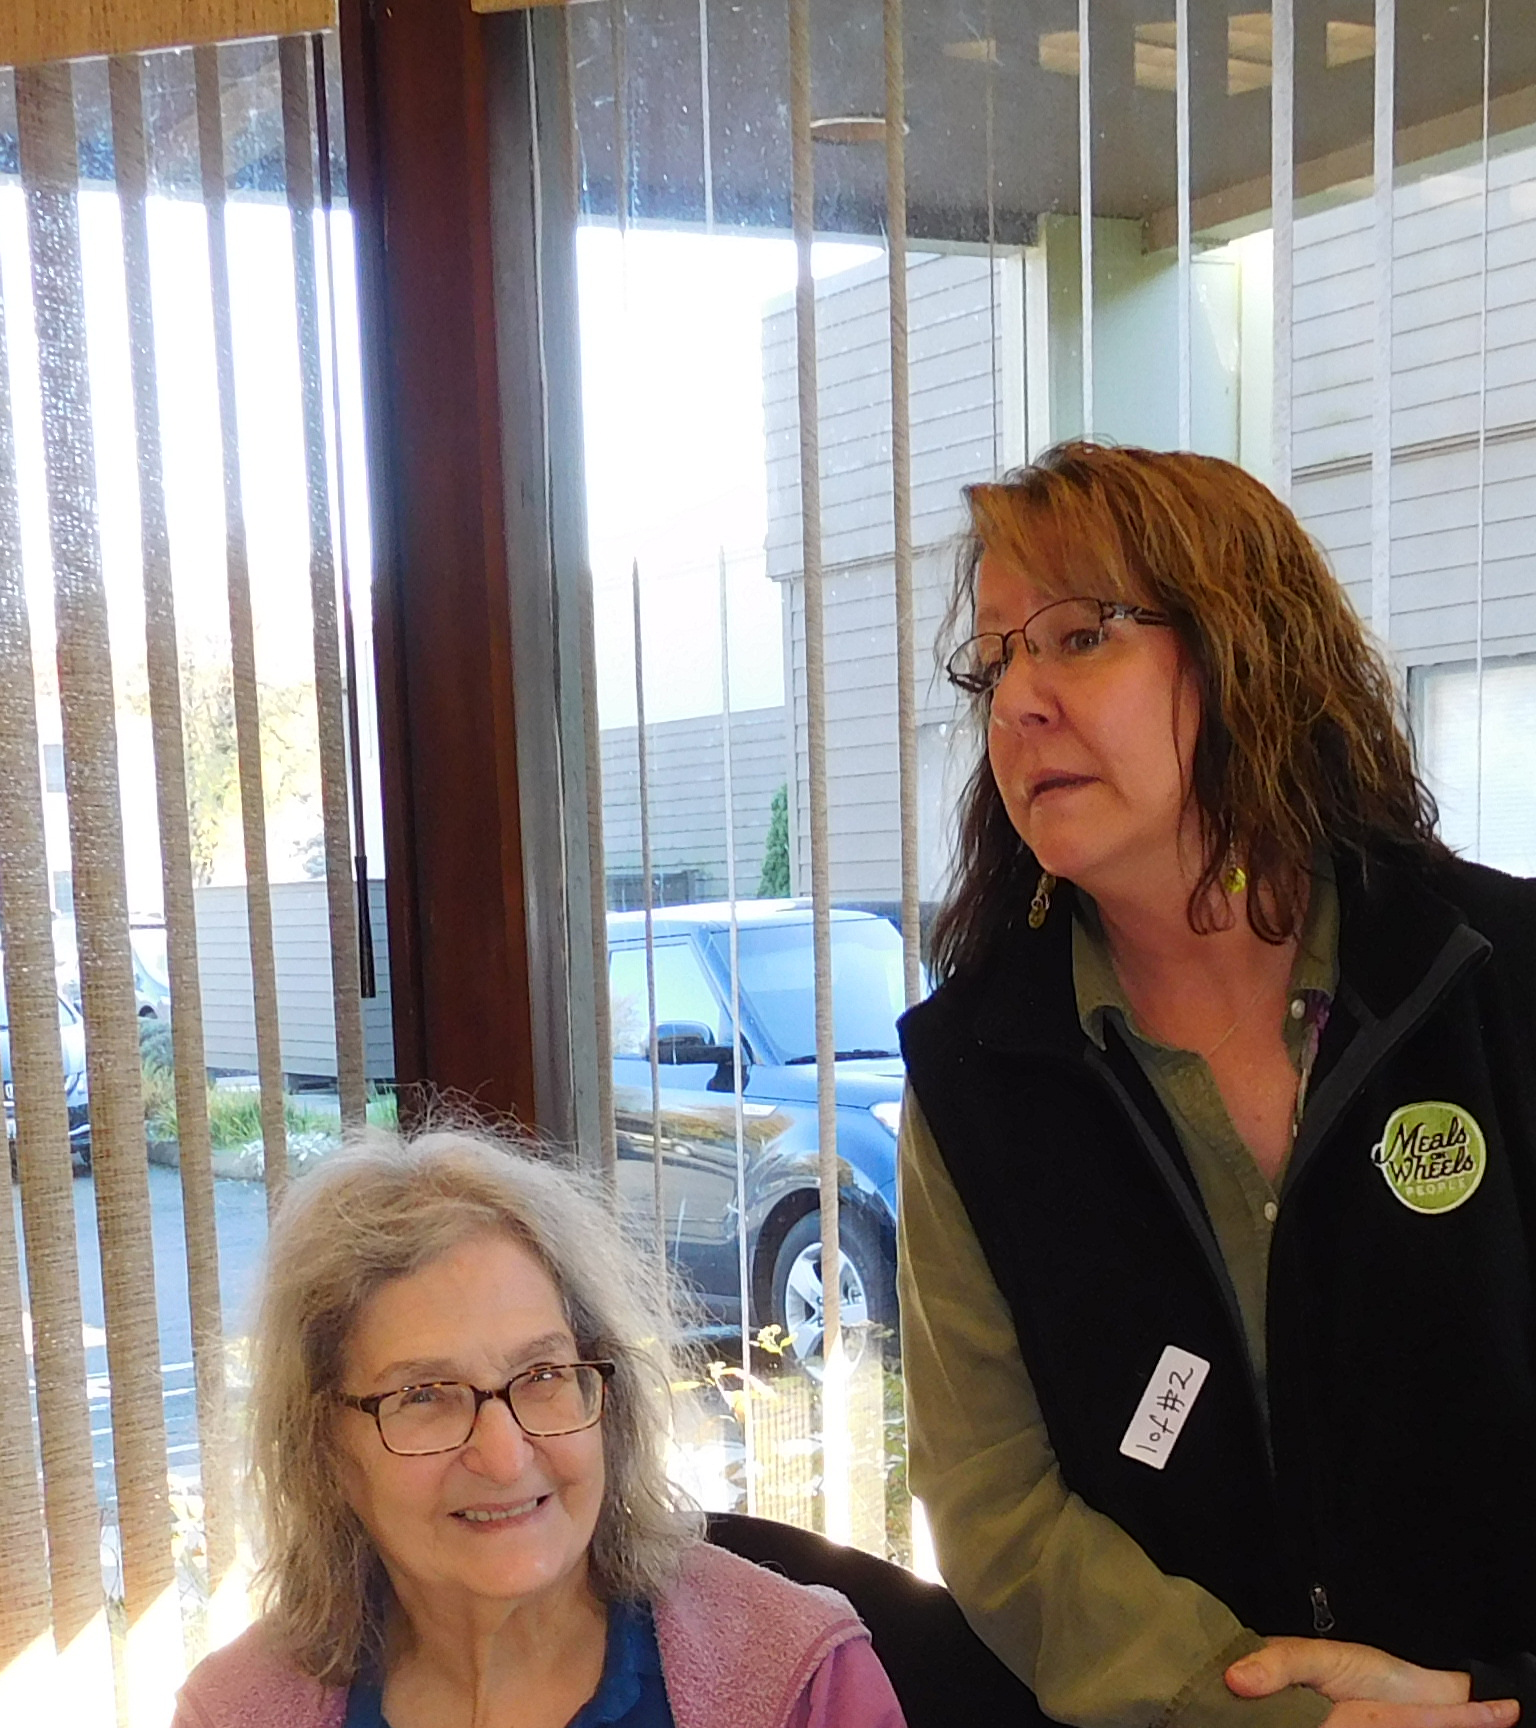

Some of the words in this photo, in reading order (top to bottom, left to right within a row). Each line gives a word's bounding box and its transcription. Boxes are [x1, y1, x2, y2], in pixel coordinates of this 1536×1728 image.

[1375, 1116, 1468, 1164] Meals
[1390, 1146, 1474, 1182] Wheels
[1406, 1179, 1468, 1196] PEOPLE
[1156, 1367, 1194, 1413] #2
